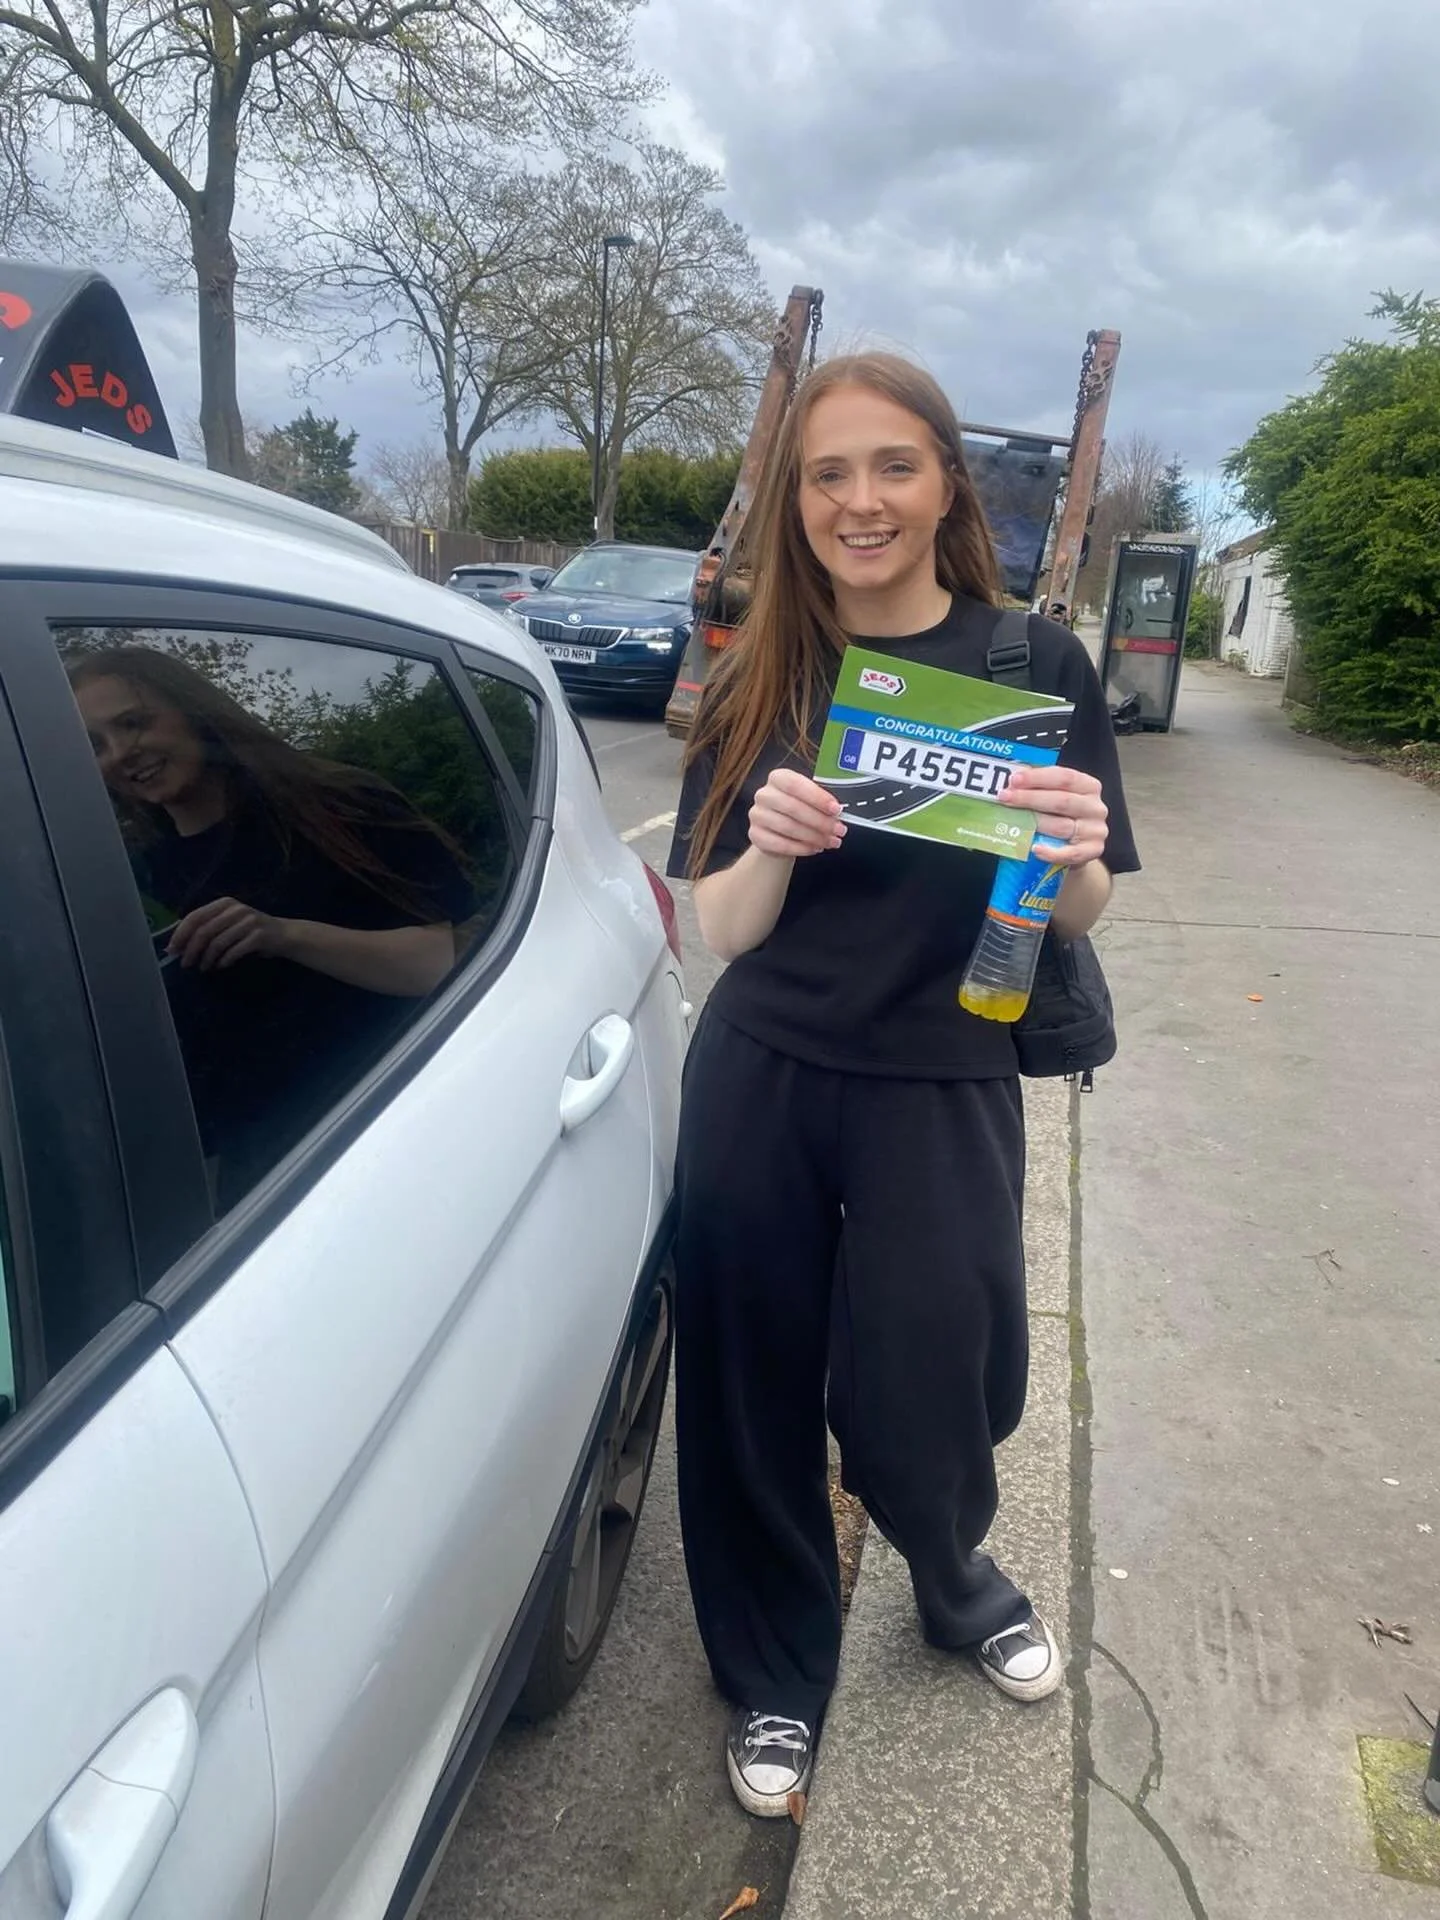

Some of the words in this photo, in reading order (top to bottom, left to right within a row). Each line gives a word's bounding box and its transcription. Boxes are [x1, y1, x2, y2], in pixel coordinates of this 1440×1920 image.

[50, 364, 152, 434] JEDS
[571, 648, 592, 661] NRN
[863, 672, 897, 689] JEDS
[874, 716, 1014, 756] CONGRATULATIONS
[843, 754, 856, 765] GB
